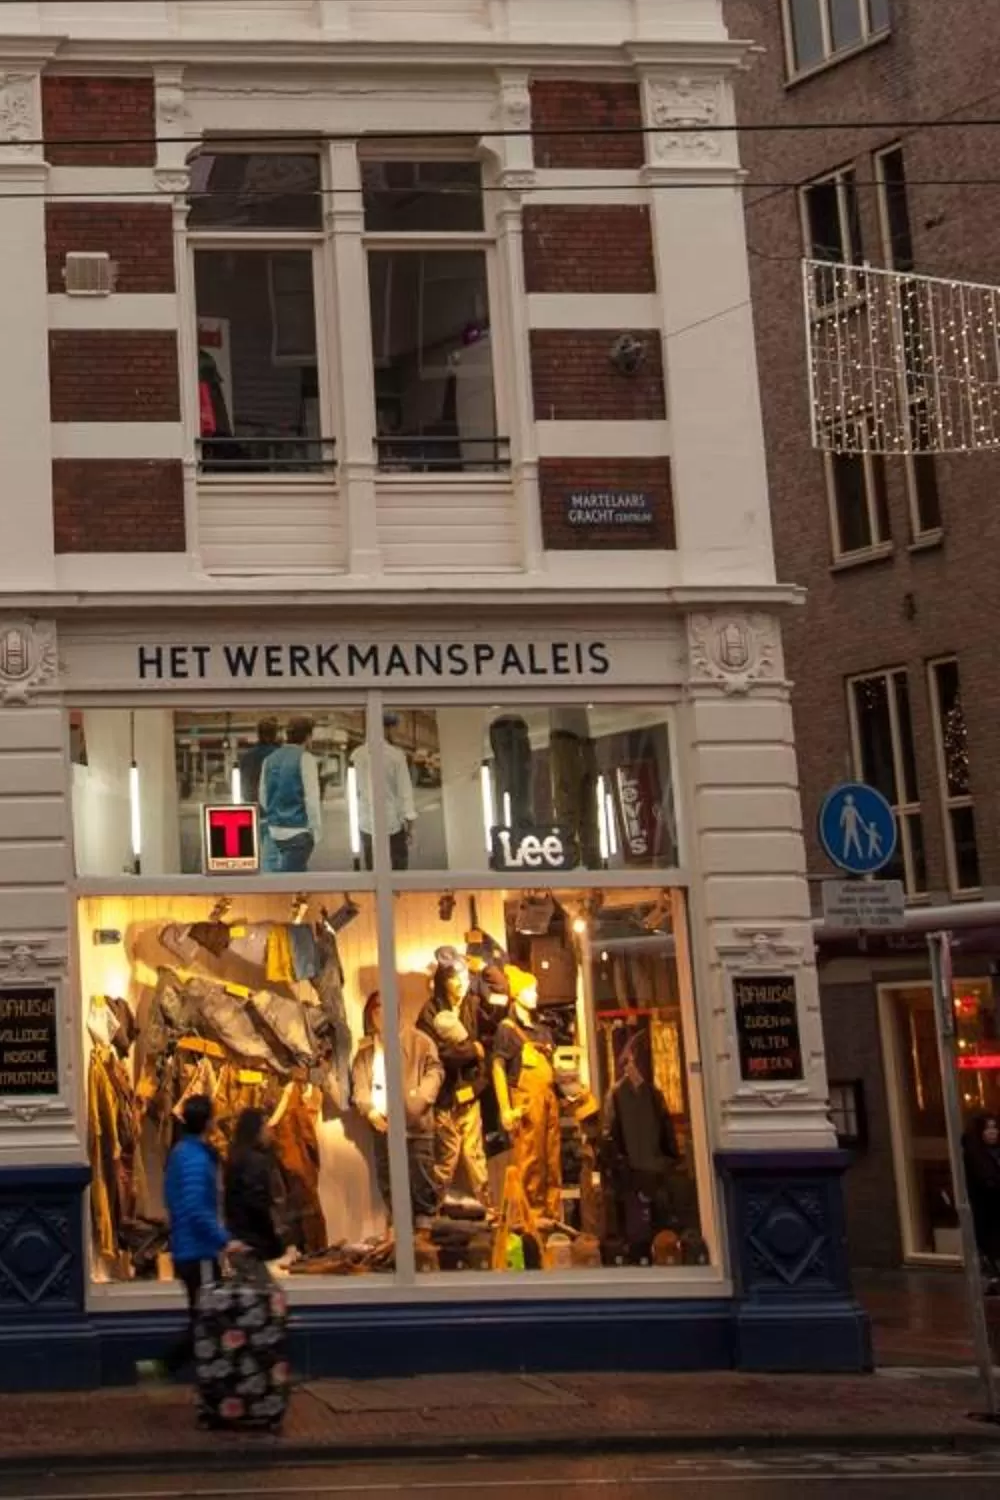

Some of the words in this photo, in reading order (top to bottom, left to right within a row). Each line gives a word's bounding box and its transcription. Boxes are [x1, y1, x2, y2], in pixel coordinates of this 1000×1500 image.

[568, 509, 615, 523] GRACHT
[571, 493, 645, 508] MARTELAARS
[138, 645, 211, 679] HET
[223, 642, 610, 677] WERKMANSPALEIS
[211, 810, 252, 858] T
[498, 830, 564, 868] Lee
